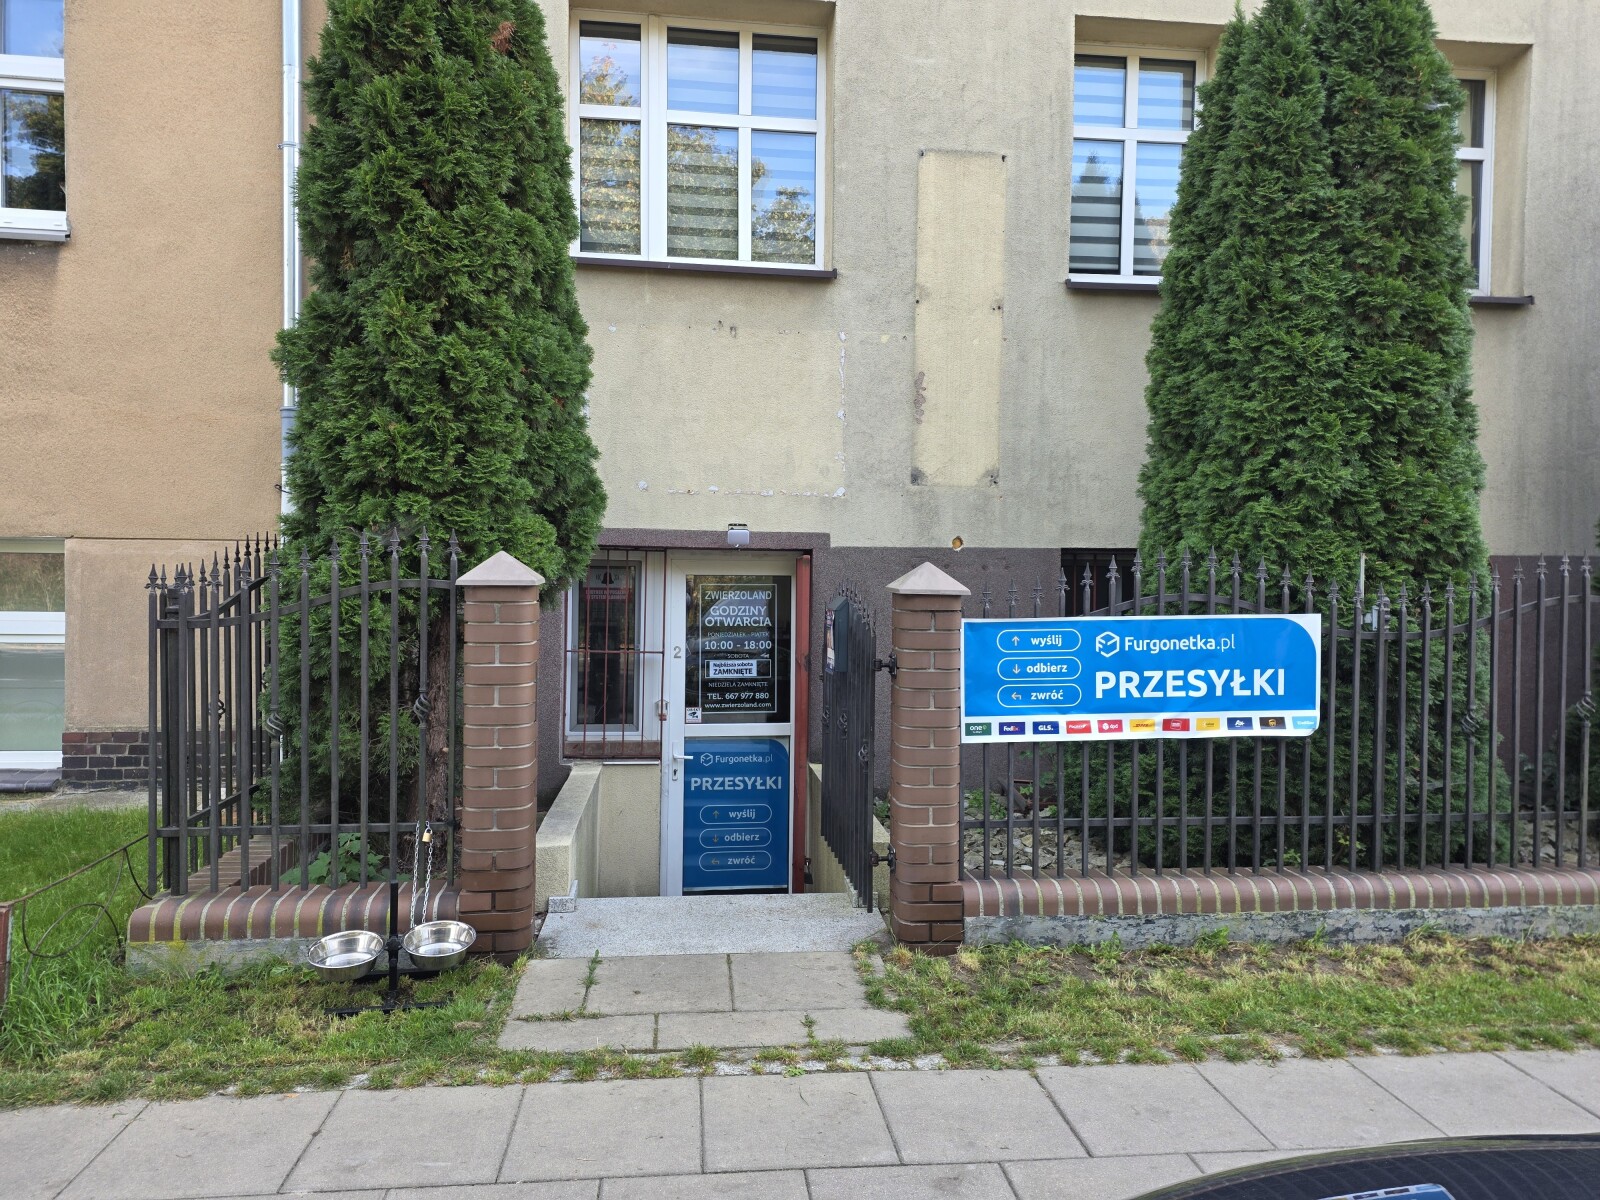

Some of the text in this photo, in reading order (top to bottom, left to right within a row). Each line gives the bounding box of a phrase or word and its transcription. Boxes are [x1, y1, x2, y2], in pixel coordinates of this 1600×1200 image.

[704, 590, 772, 600] ZWIERZOLAND
[710, 605, 767, 616] GODZINY
[704, 616, 772, 627] OTWARCIA
[704, 640, 734, 650] 10:00
[743, 640, 772, 650] 18:00
[1030, 634, 1063, 648] wyślij
[1124, 633, 1236, 654] Furgonetka.pl
[673, 645, 682, 659] 2
[712, 667, 753, 677] ZAMKNIĘTE
[1026, 662, 1068, 674] odbierz
[1095, 668, 1286, 699] PRZESYŁKI
[725, 692, 739, 700] 667
[740, 692, 754, 700] 977
[1030, 688, 1064, 701] zwróć
[704, 701, 772, 709] www.zwierzoland.com
[715, 754, 773, 765] Furgonetka.pl
[690, 776, 783, 791] PRZESYŁKI
[728, 809, 756, 820] wyślij
[724, 833, 760, 842] odbierz
[727, 855, 756, 865] zwróć
